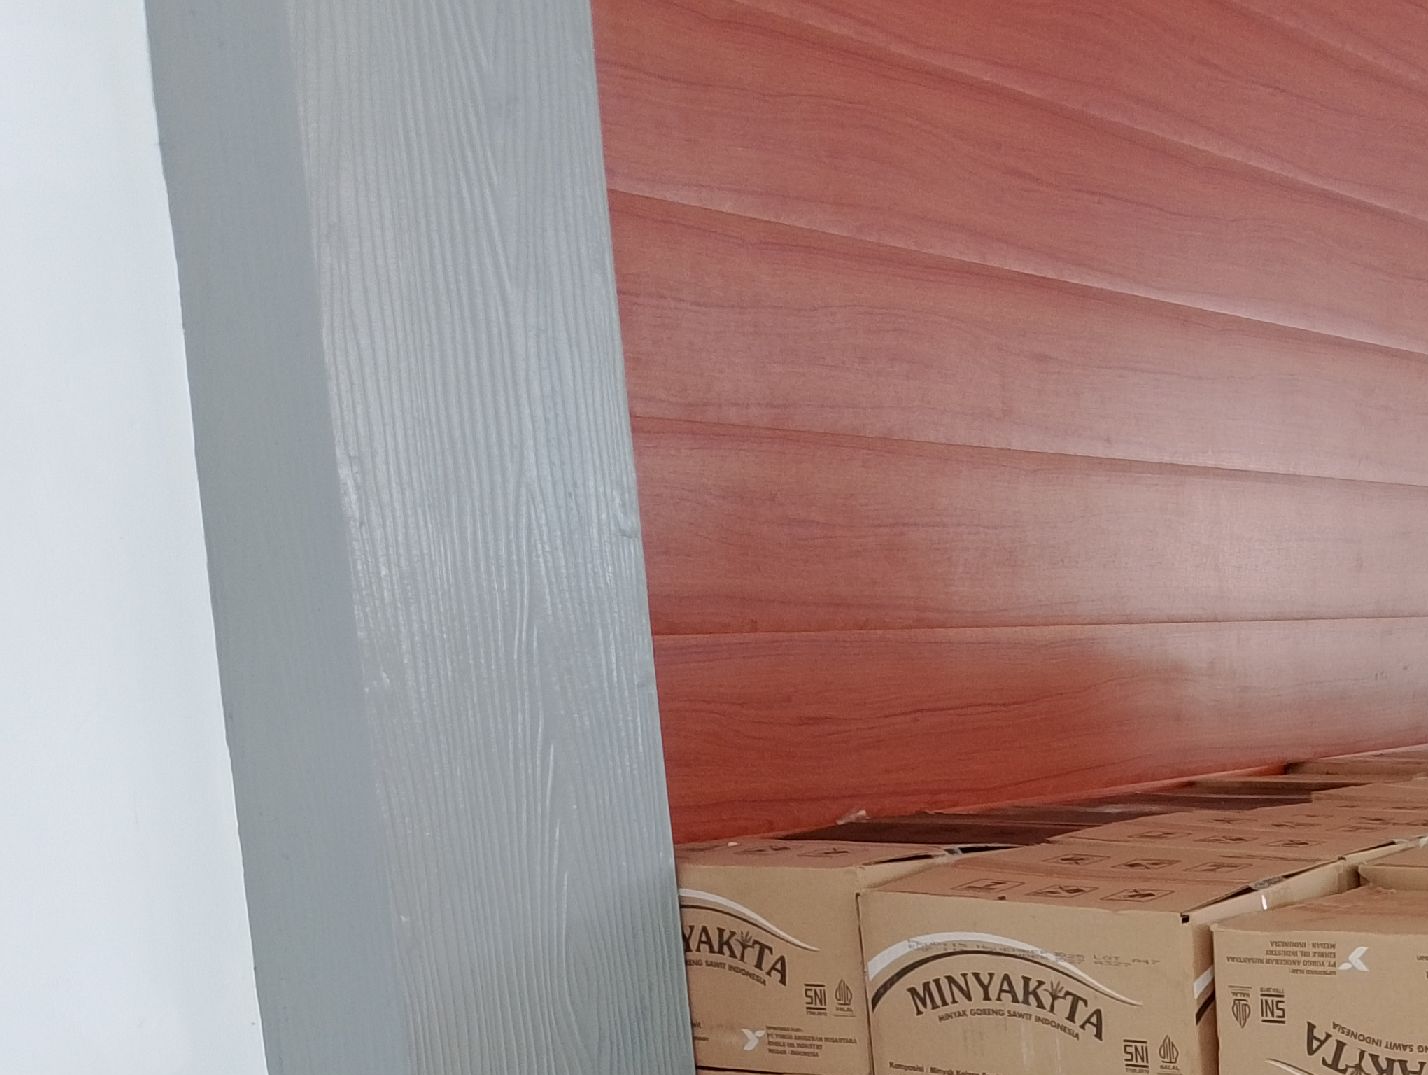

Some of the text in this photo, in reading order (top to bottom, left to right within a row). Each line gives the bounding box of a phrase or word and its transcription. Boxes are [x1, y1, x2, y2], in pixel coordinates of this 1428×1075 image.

[803, 988, 826, 1006] SNI
[1260, 998, 1286, 1018] SNI
[1332, 1021, 1382, 1048] INDONESIA
[1123, 1043, 1148, 1063] SNI
[1384, 1041, 1414, 1052] SAWIT
